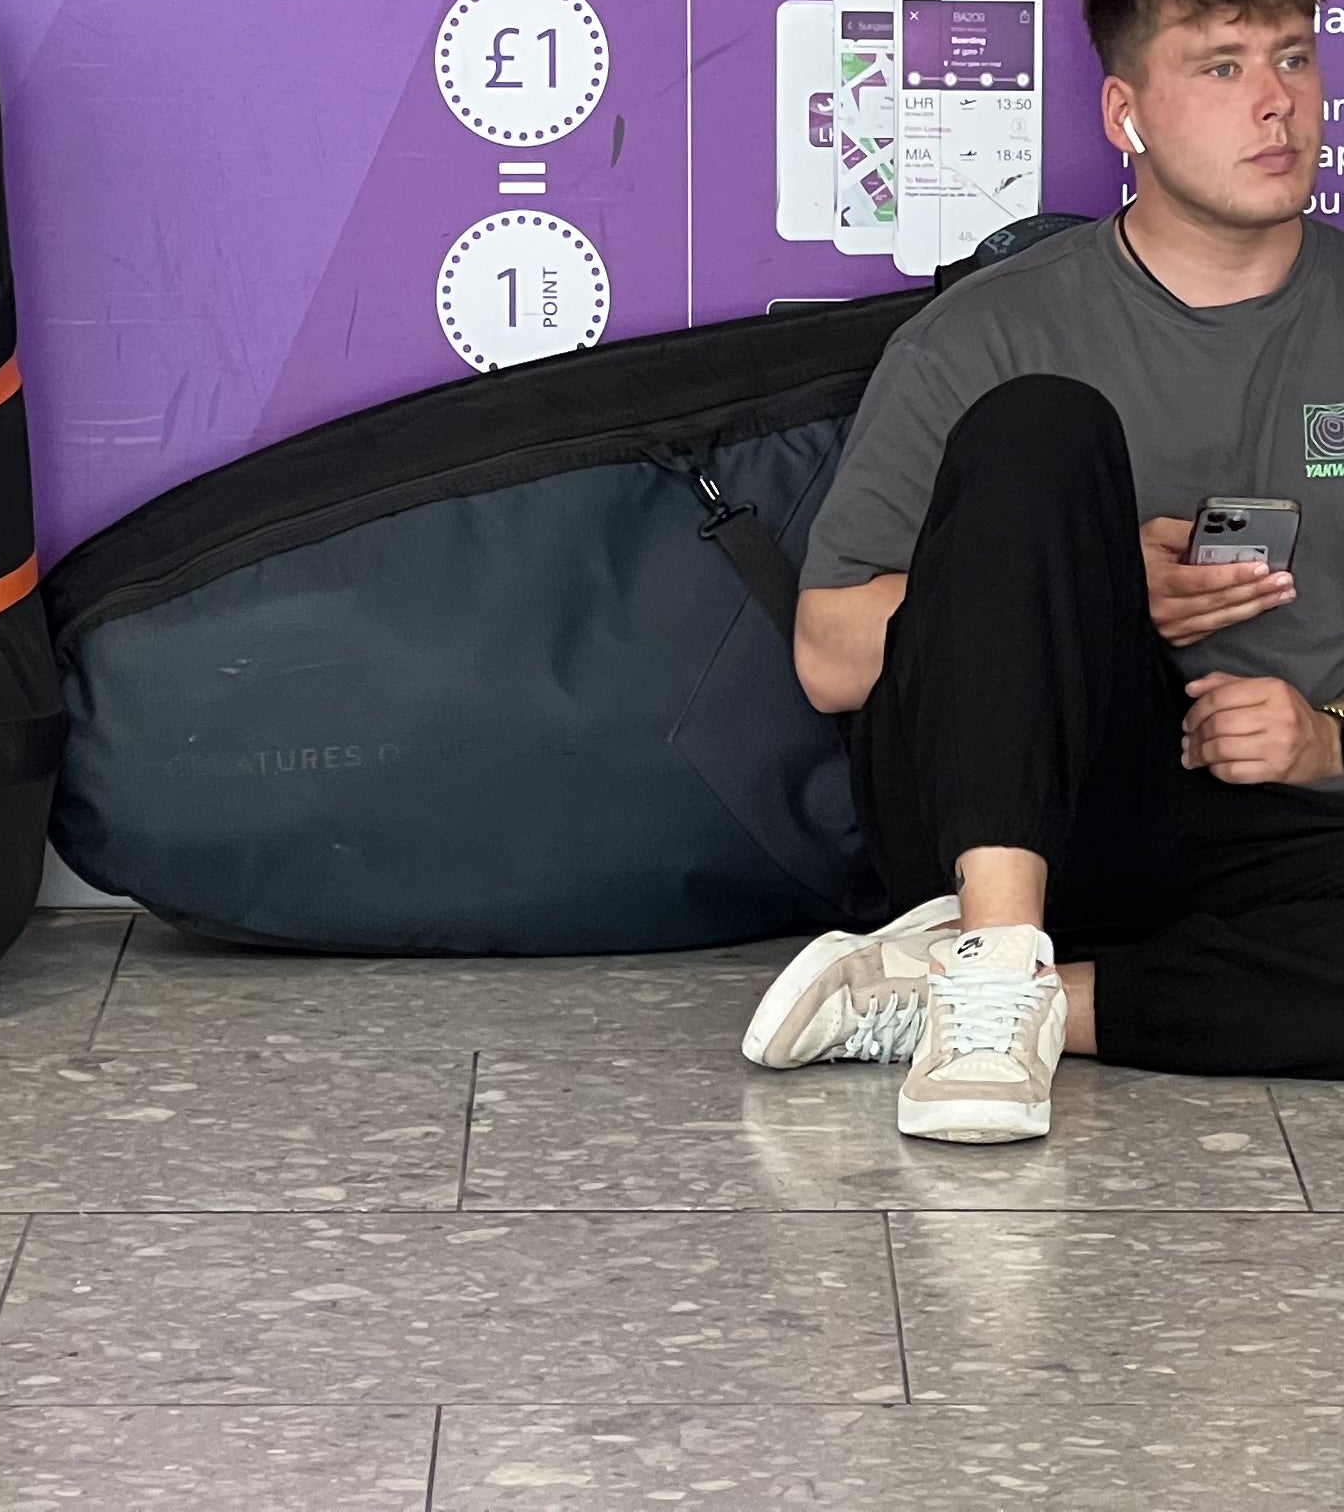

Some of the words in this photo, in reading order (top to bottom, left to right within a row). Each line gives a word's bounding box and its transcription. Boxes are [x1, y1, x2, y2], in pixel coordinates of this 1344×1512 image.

[485, 28, 557, 89] £1
[905, 97, 934, 110] LHR
[996, 98, 1033, 110] 13:50
[905, 148, 932, 161] MIA
[996, 149, 1033, 161] 18:45
[497, 268, 517, 328] 1
[542, 267, 558, 328] POINT
